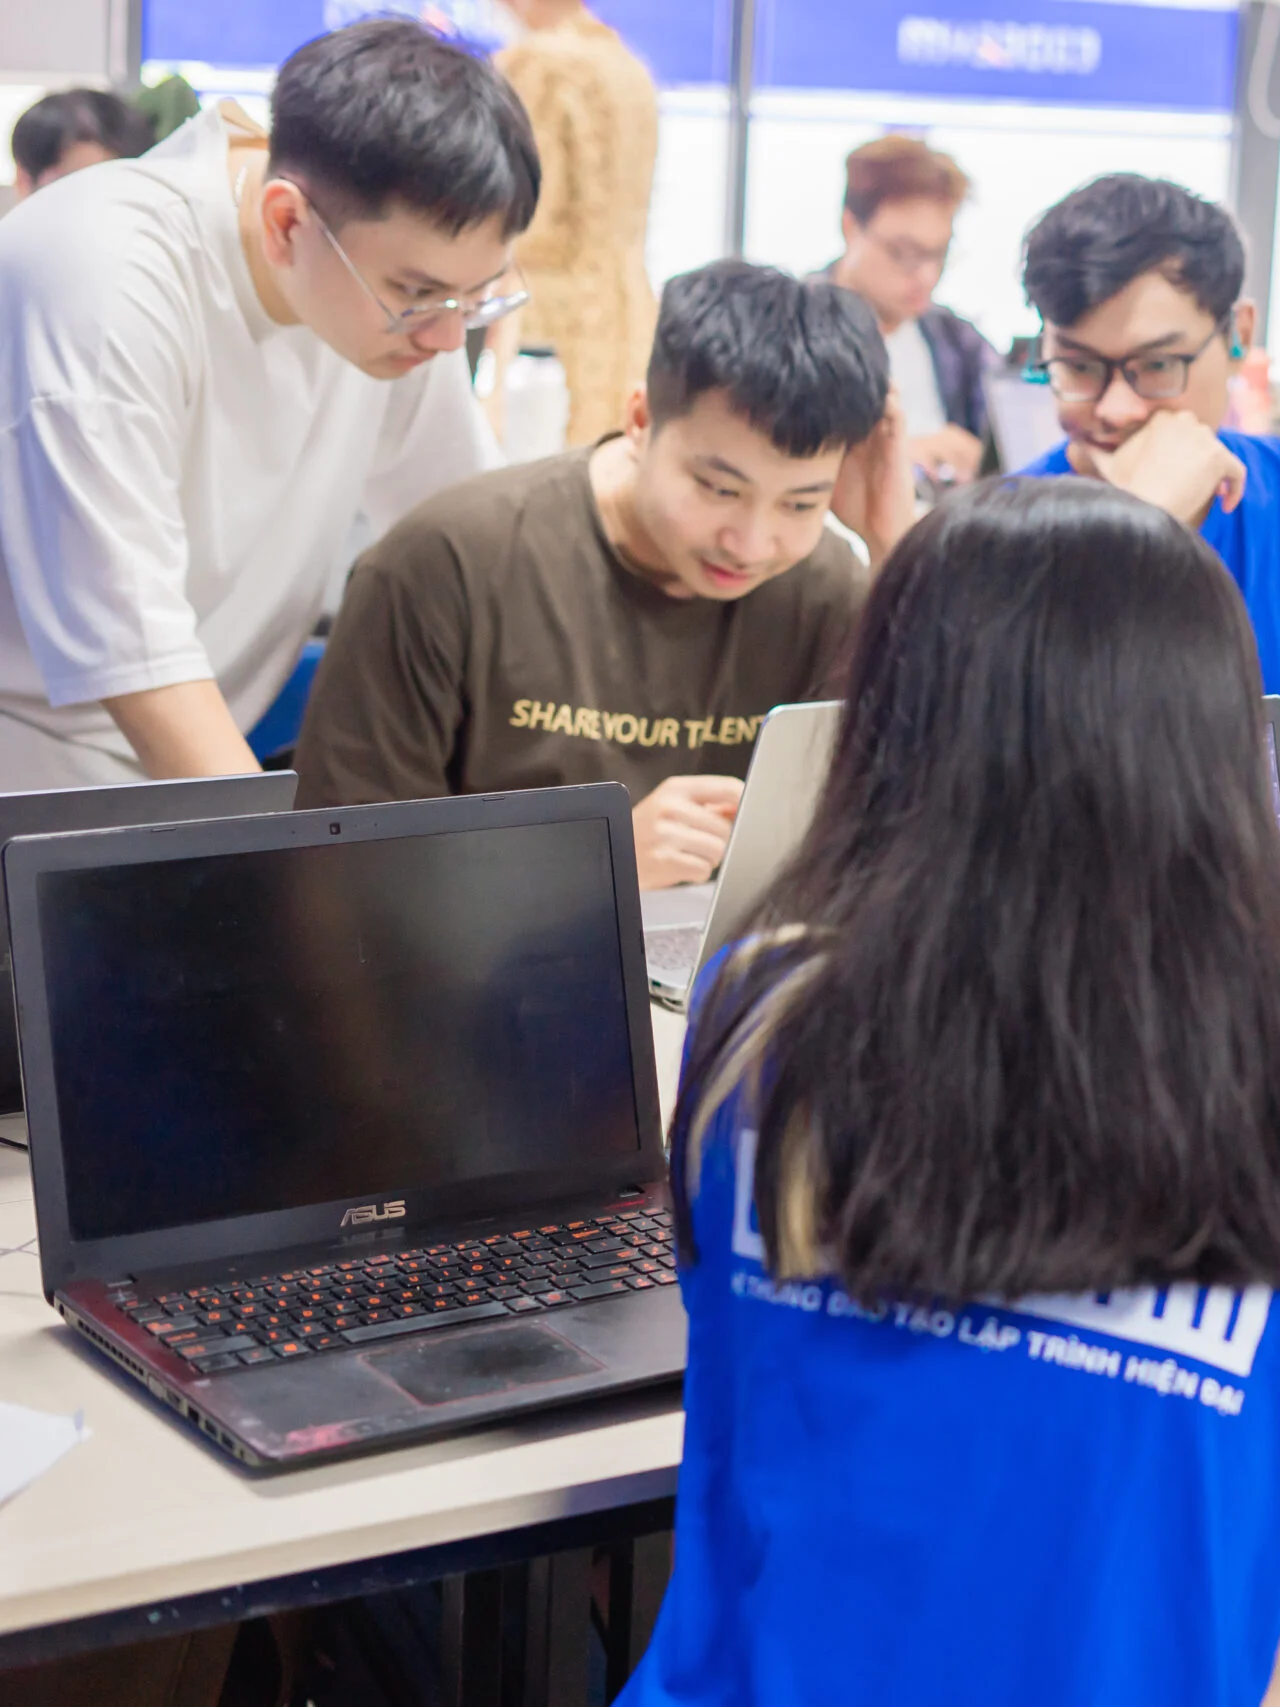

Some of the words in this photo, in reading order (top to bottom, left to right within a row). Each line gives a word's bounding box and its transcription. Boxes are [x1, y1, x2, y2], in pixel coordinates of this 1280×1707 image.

[602, 711, 680, 749] YOUR
[683, 714, 766, 751] TLEN
[340, 1199, 406, 1227] ASUS
